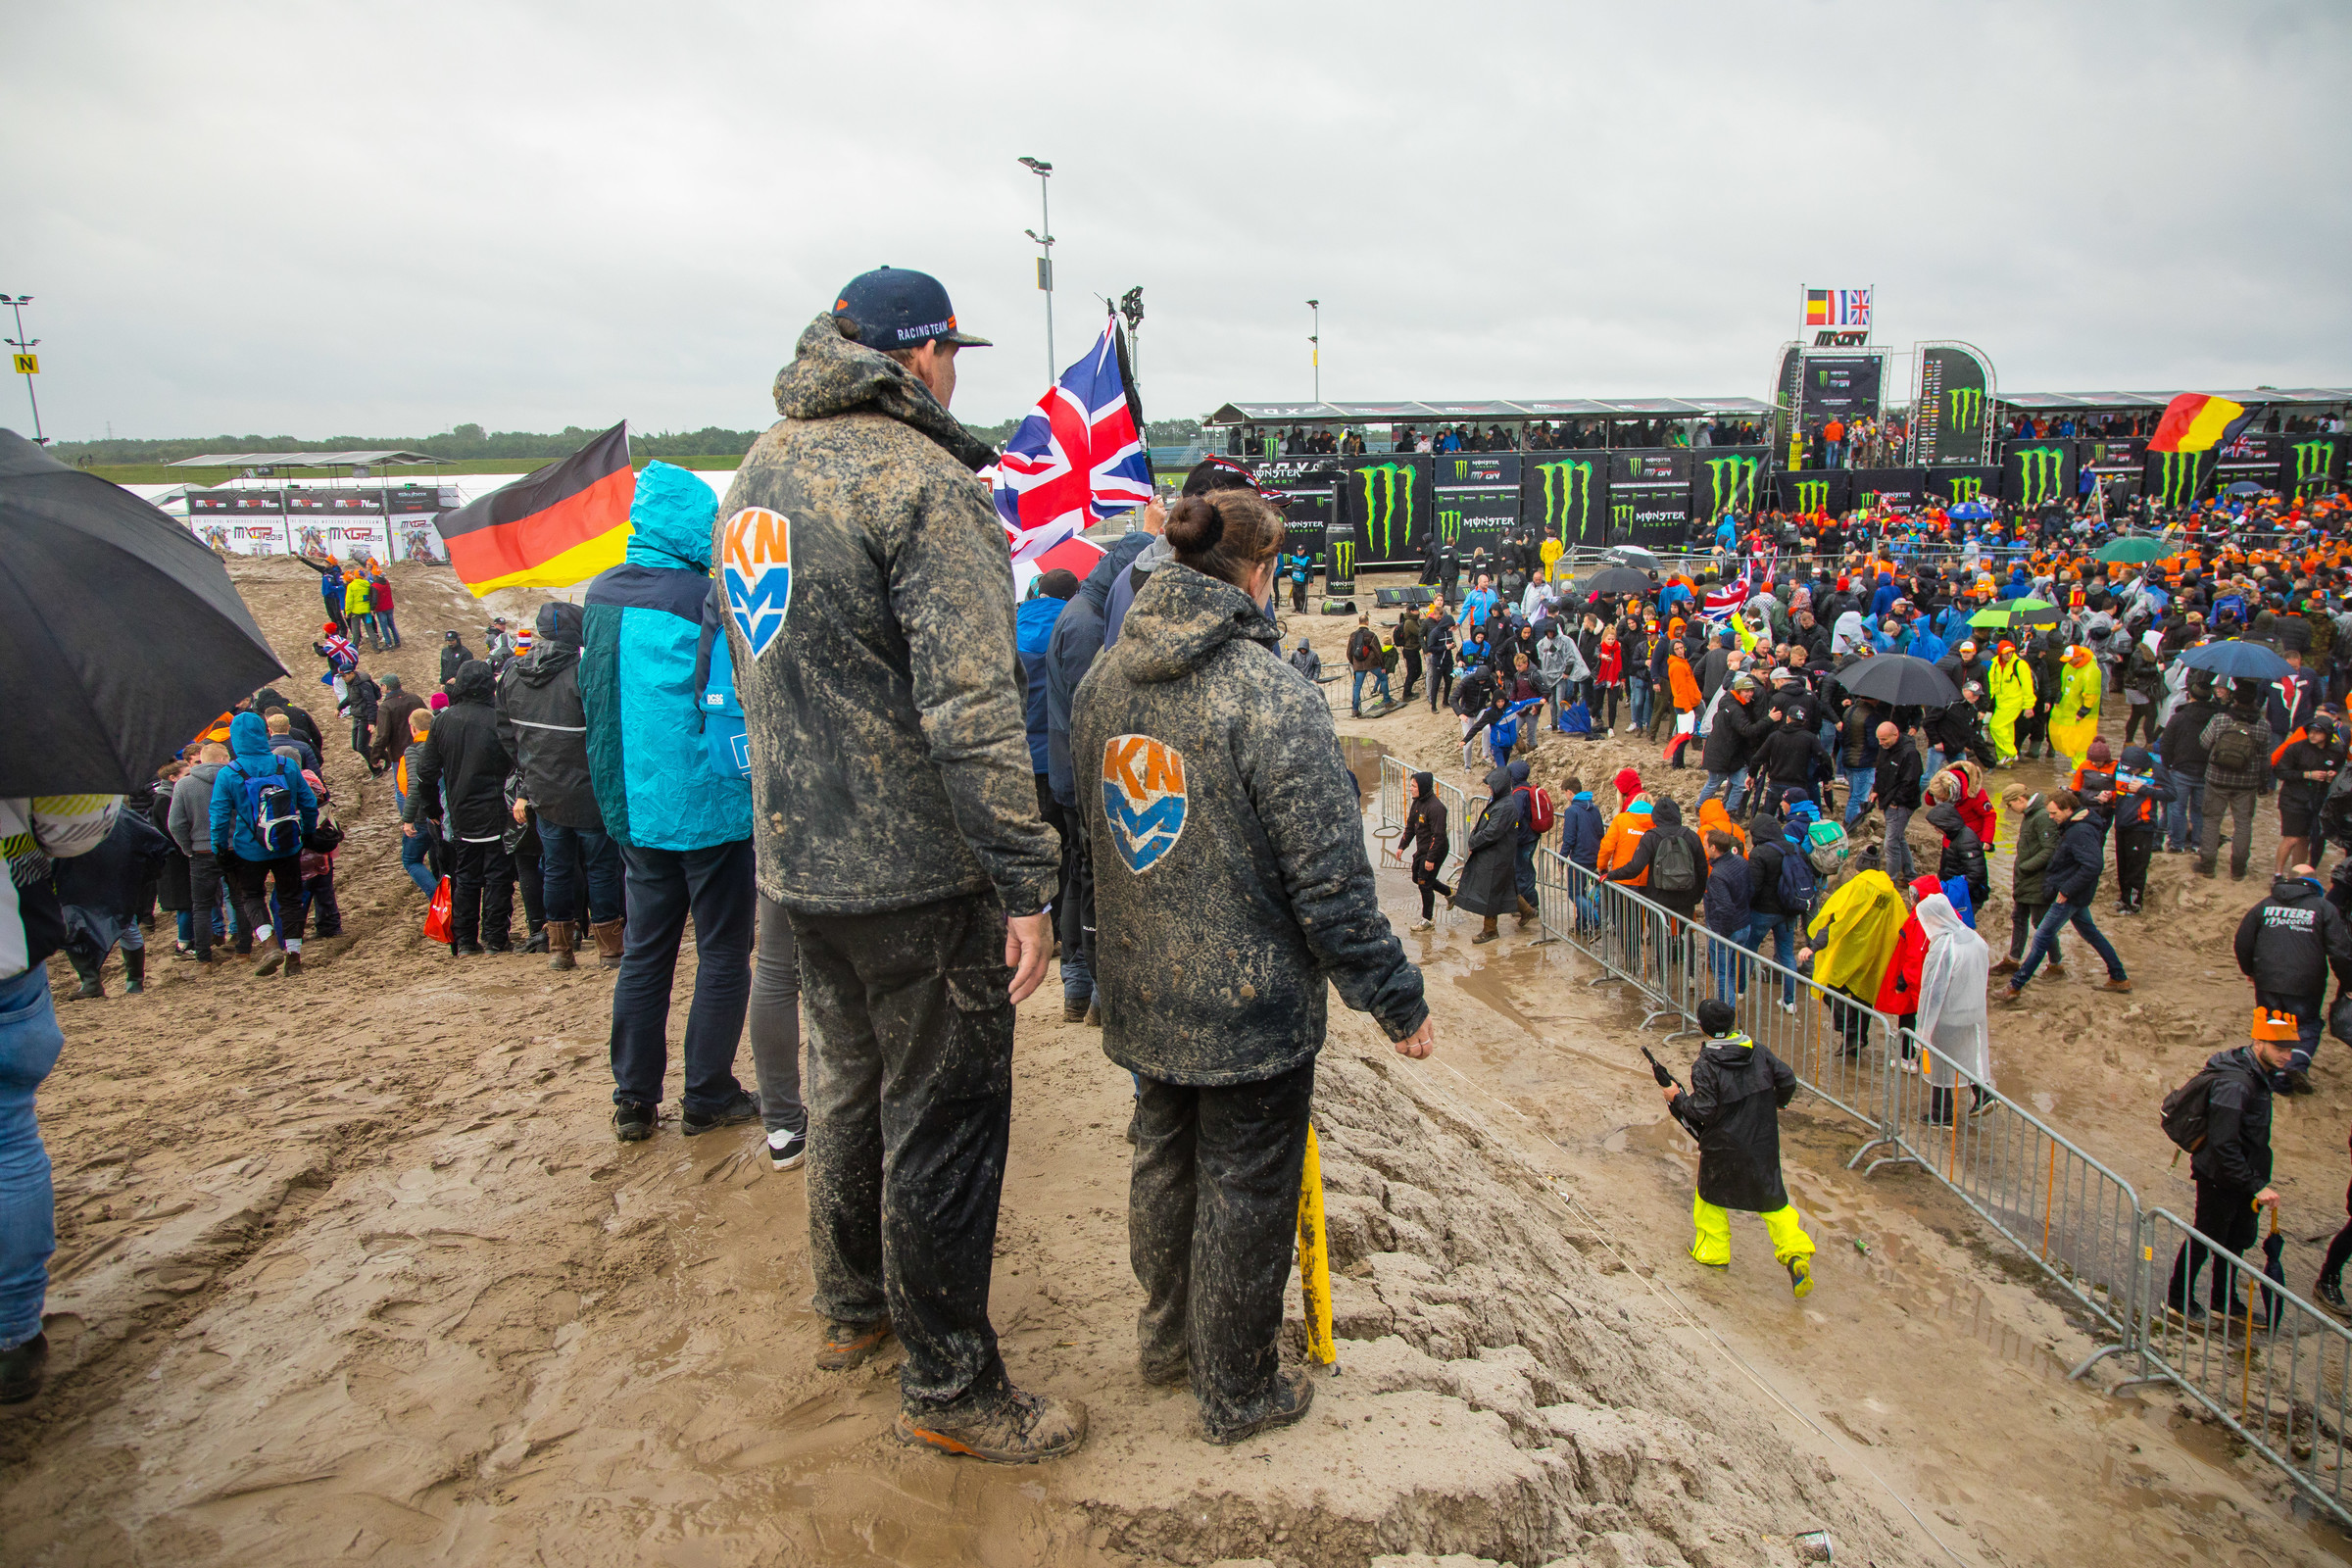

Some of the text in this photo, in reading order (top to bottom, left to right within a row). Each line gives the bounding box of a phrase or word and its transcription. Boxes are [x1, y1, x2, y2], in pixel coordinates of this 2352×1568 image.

[897, 320, 949, 341] RACING TEAM
[20, 357, 34, 370] N
[1463, 516, 1515, 527] MONSTER
[1636, 511, 1686, 522] MONSTER
[1284, 520, 1324, 529] MONSTER
[234, 526, 272, 539] MXGP
[329, 527, 372, 540] MXGP
